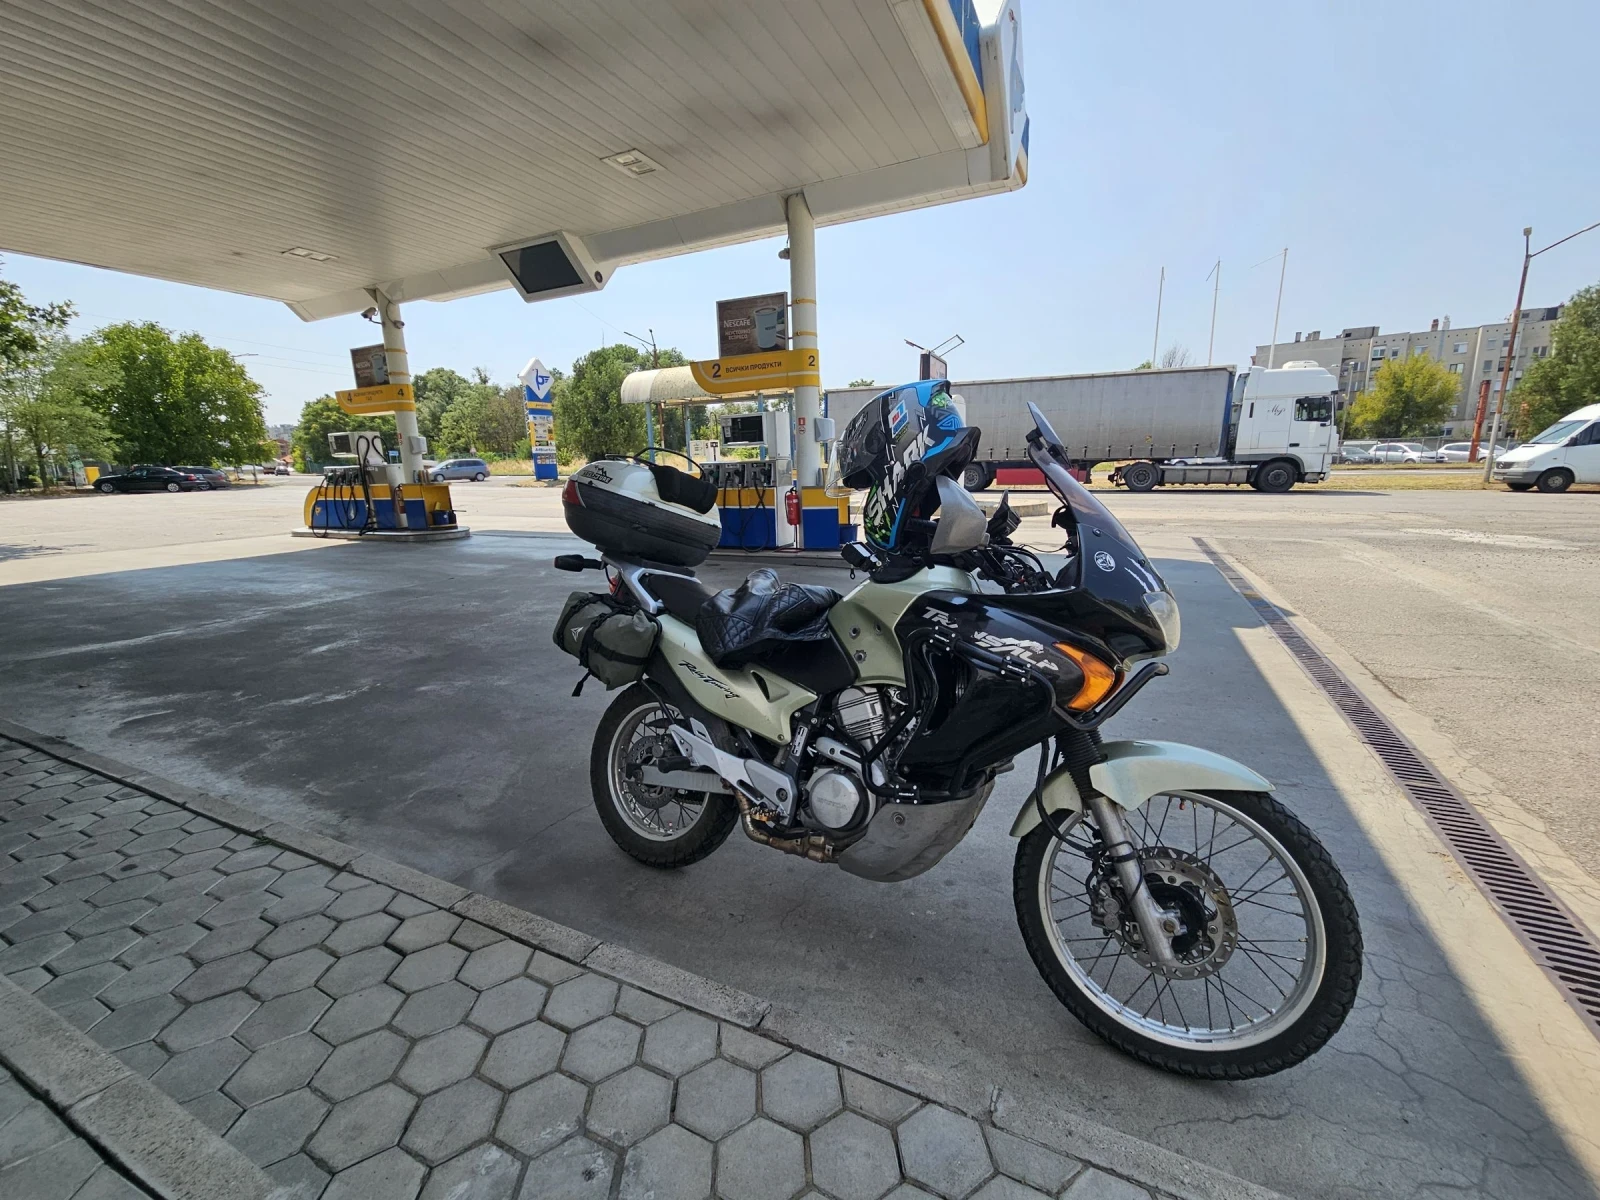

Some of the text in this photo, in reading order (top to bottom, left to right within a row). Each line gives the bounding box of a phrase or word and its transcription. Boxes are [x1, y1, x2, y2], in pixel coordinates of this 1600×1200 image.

[808, 355, 816, 367] 2
[712, 361, 782, 379] 2 ВСИЧКИ ПРОДУКТИ
[397, 388, 405, 397] 4
[867, 423, 936, 527] SHARK
